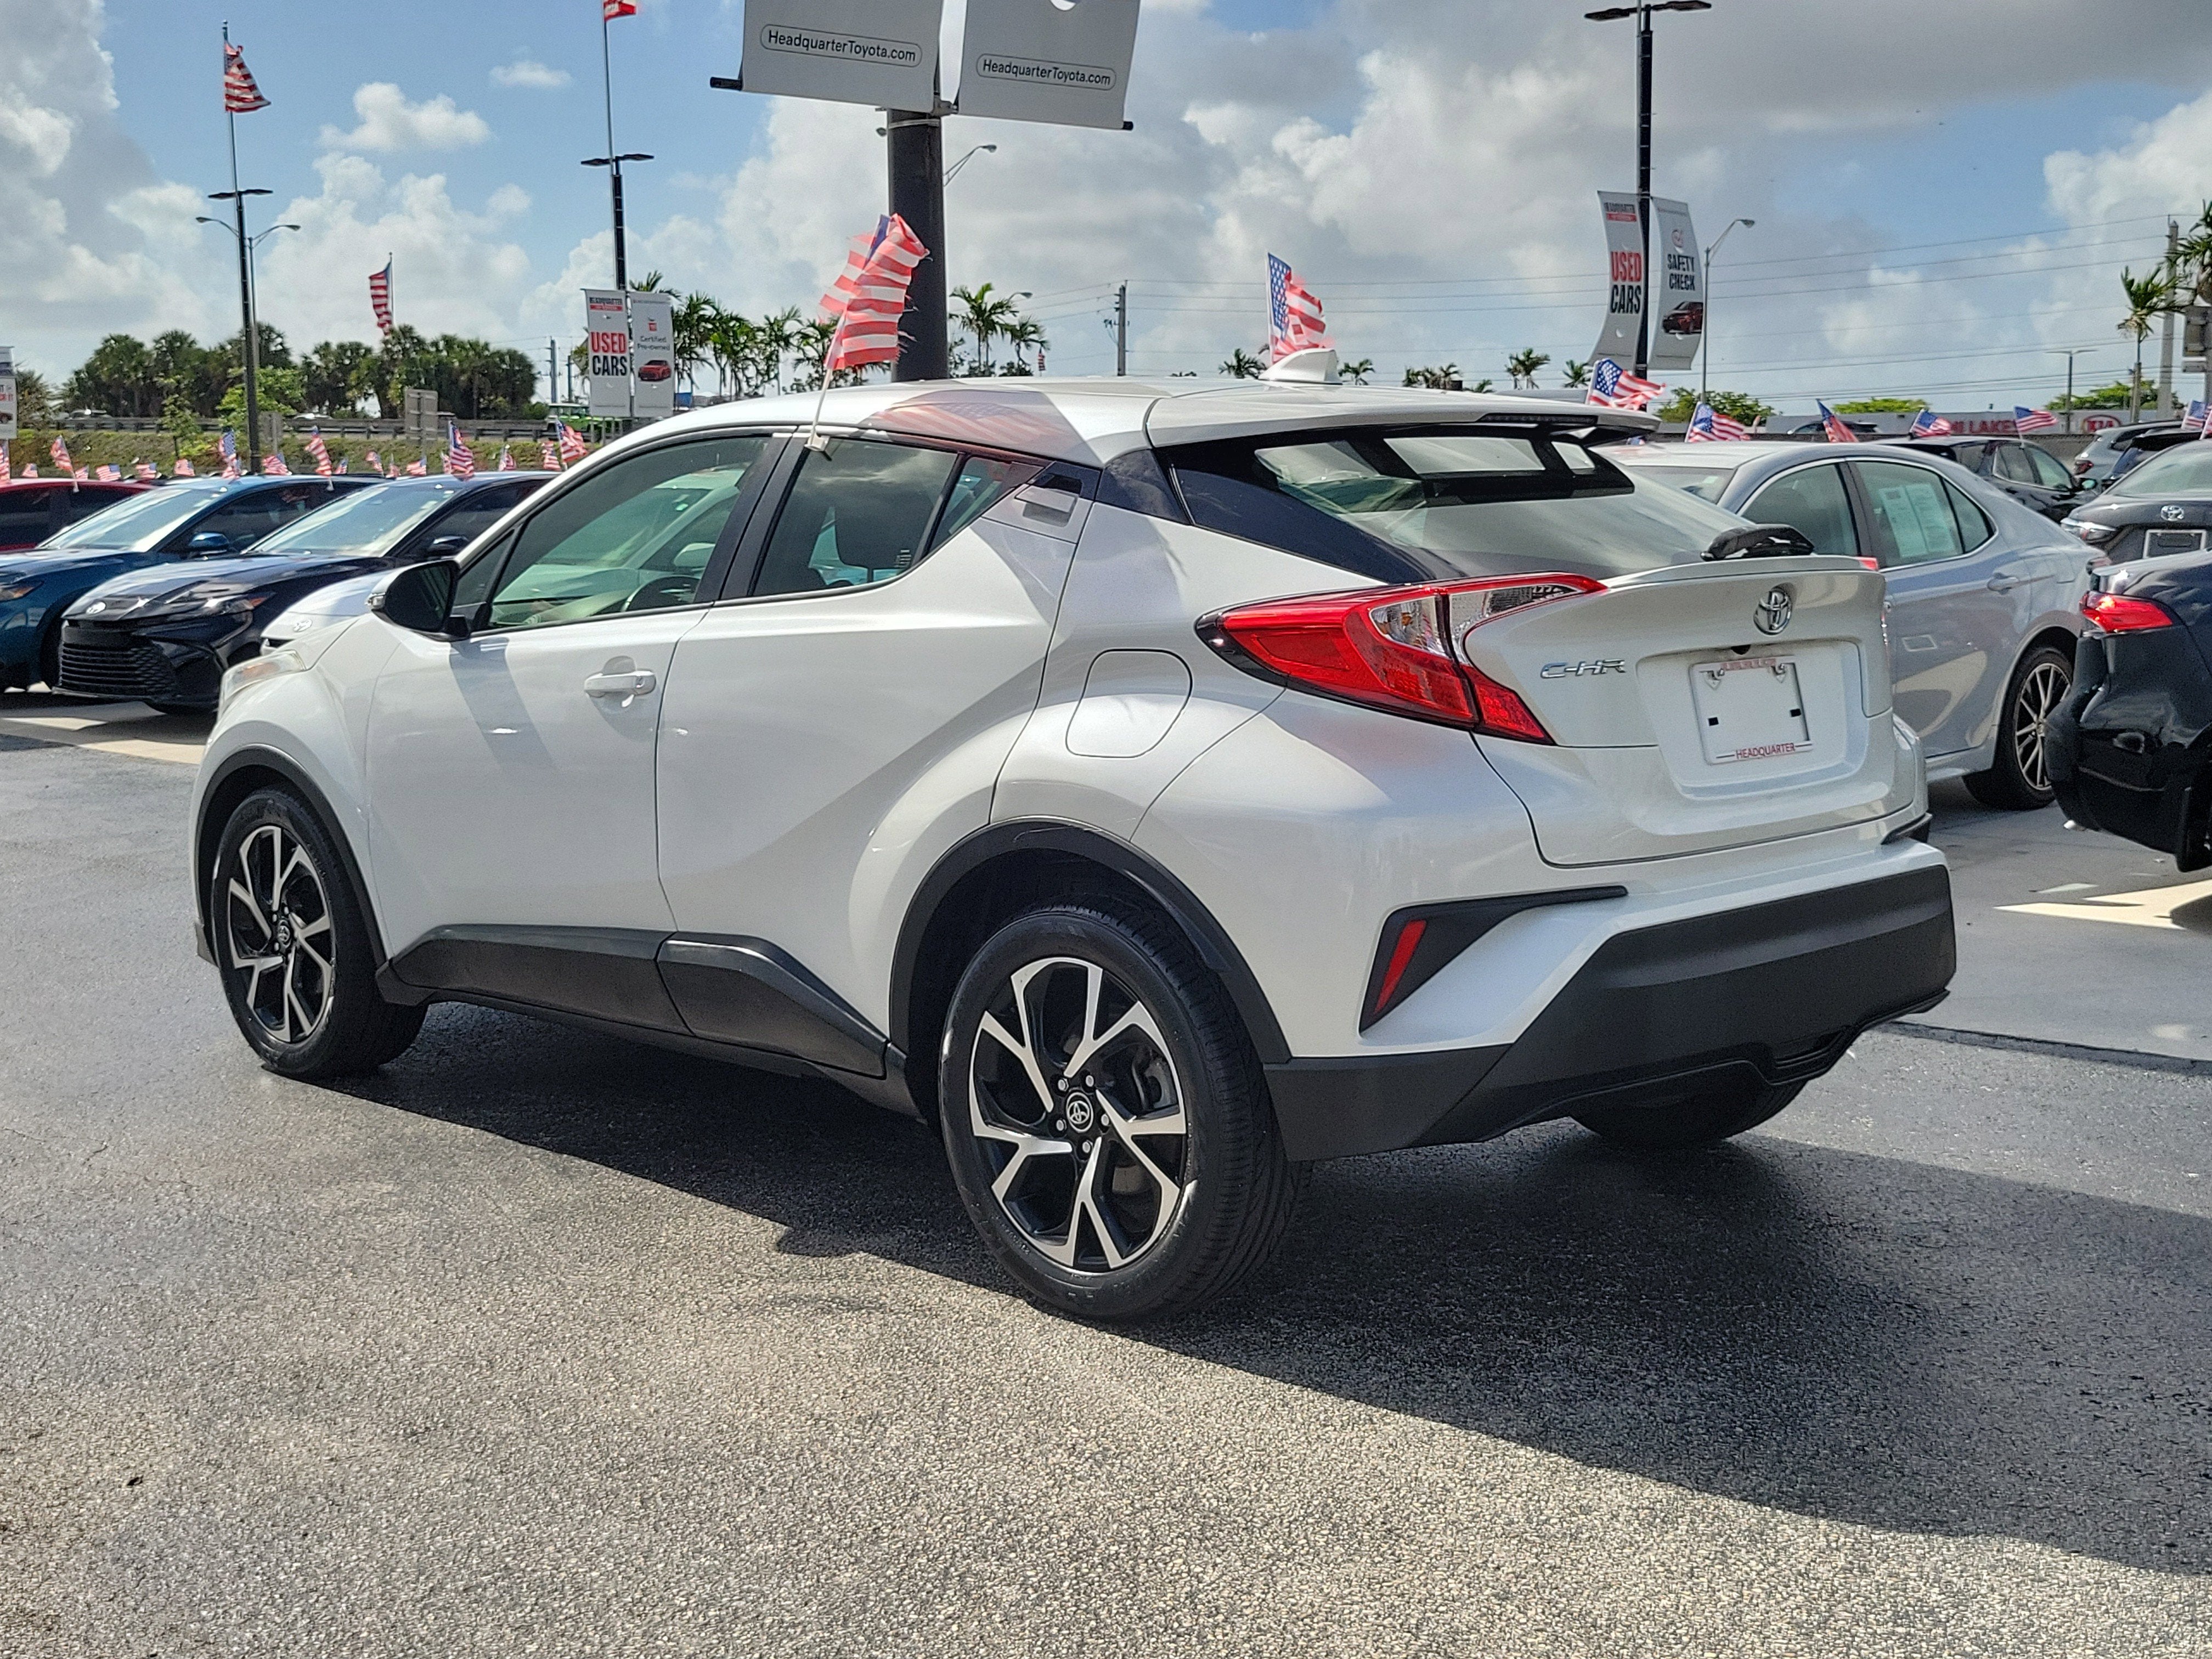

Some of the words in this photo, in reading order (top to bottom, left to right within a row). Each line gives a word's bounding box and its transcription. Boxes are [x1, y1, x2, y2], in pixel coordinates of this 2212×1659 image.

[768, 30, 916, 62] HeadquarterToyota.com
[983, 59, 1111, 86] HeadquarterToyota.com
[1610, 250, 1642, 283] USED
[1667, 254, 1695, 272] SAFETY
[1669, 274, 1695, 291] CHECK
[1610, 285, 1641, 314] CARS
[590, 332, 626, 354] USED
[592, 356, 628, 376] CARS
[1540, 659, 1626, 679] C-HR
[1735, 742, 1796, 759] HEADQUARTER
